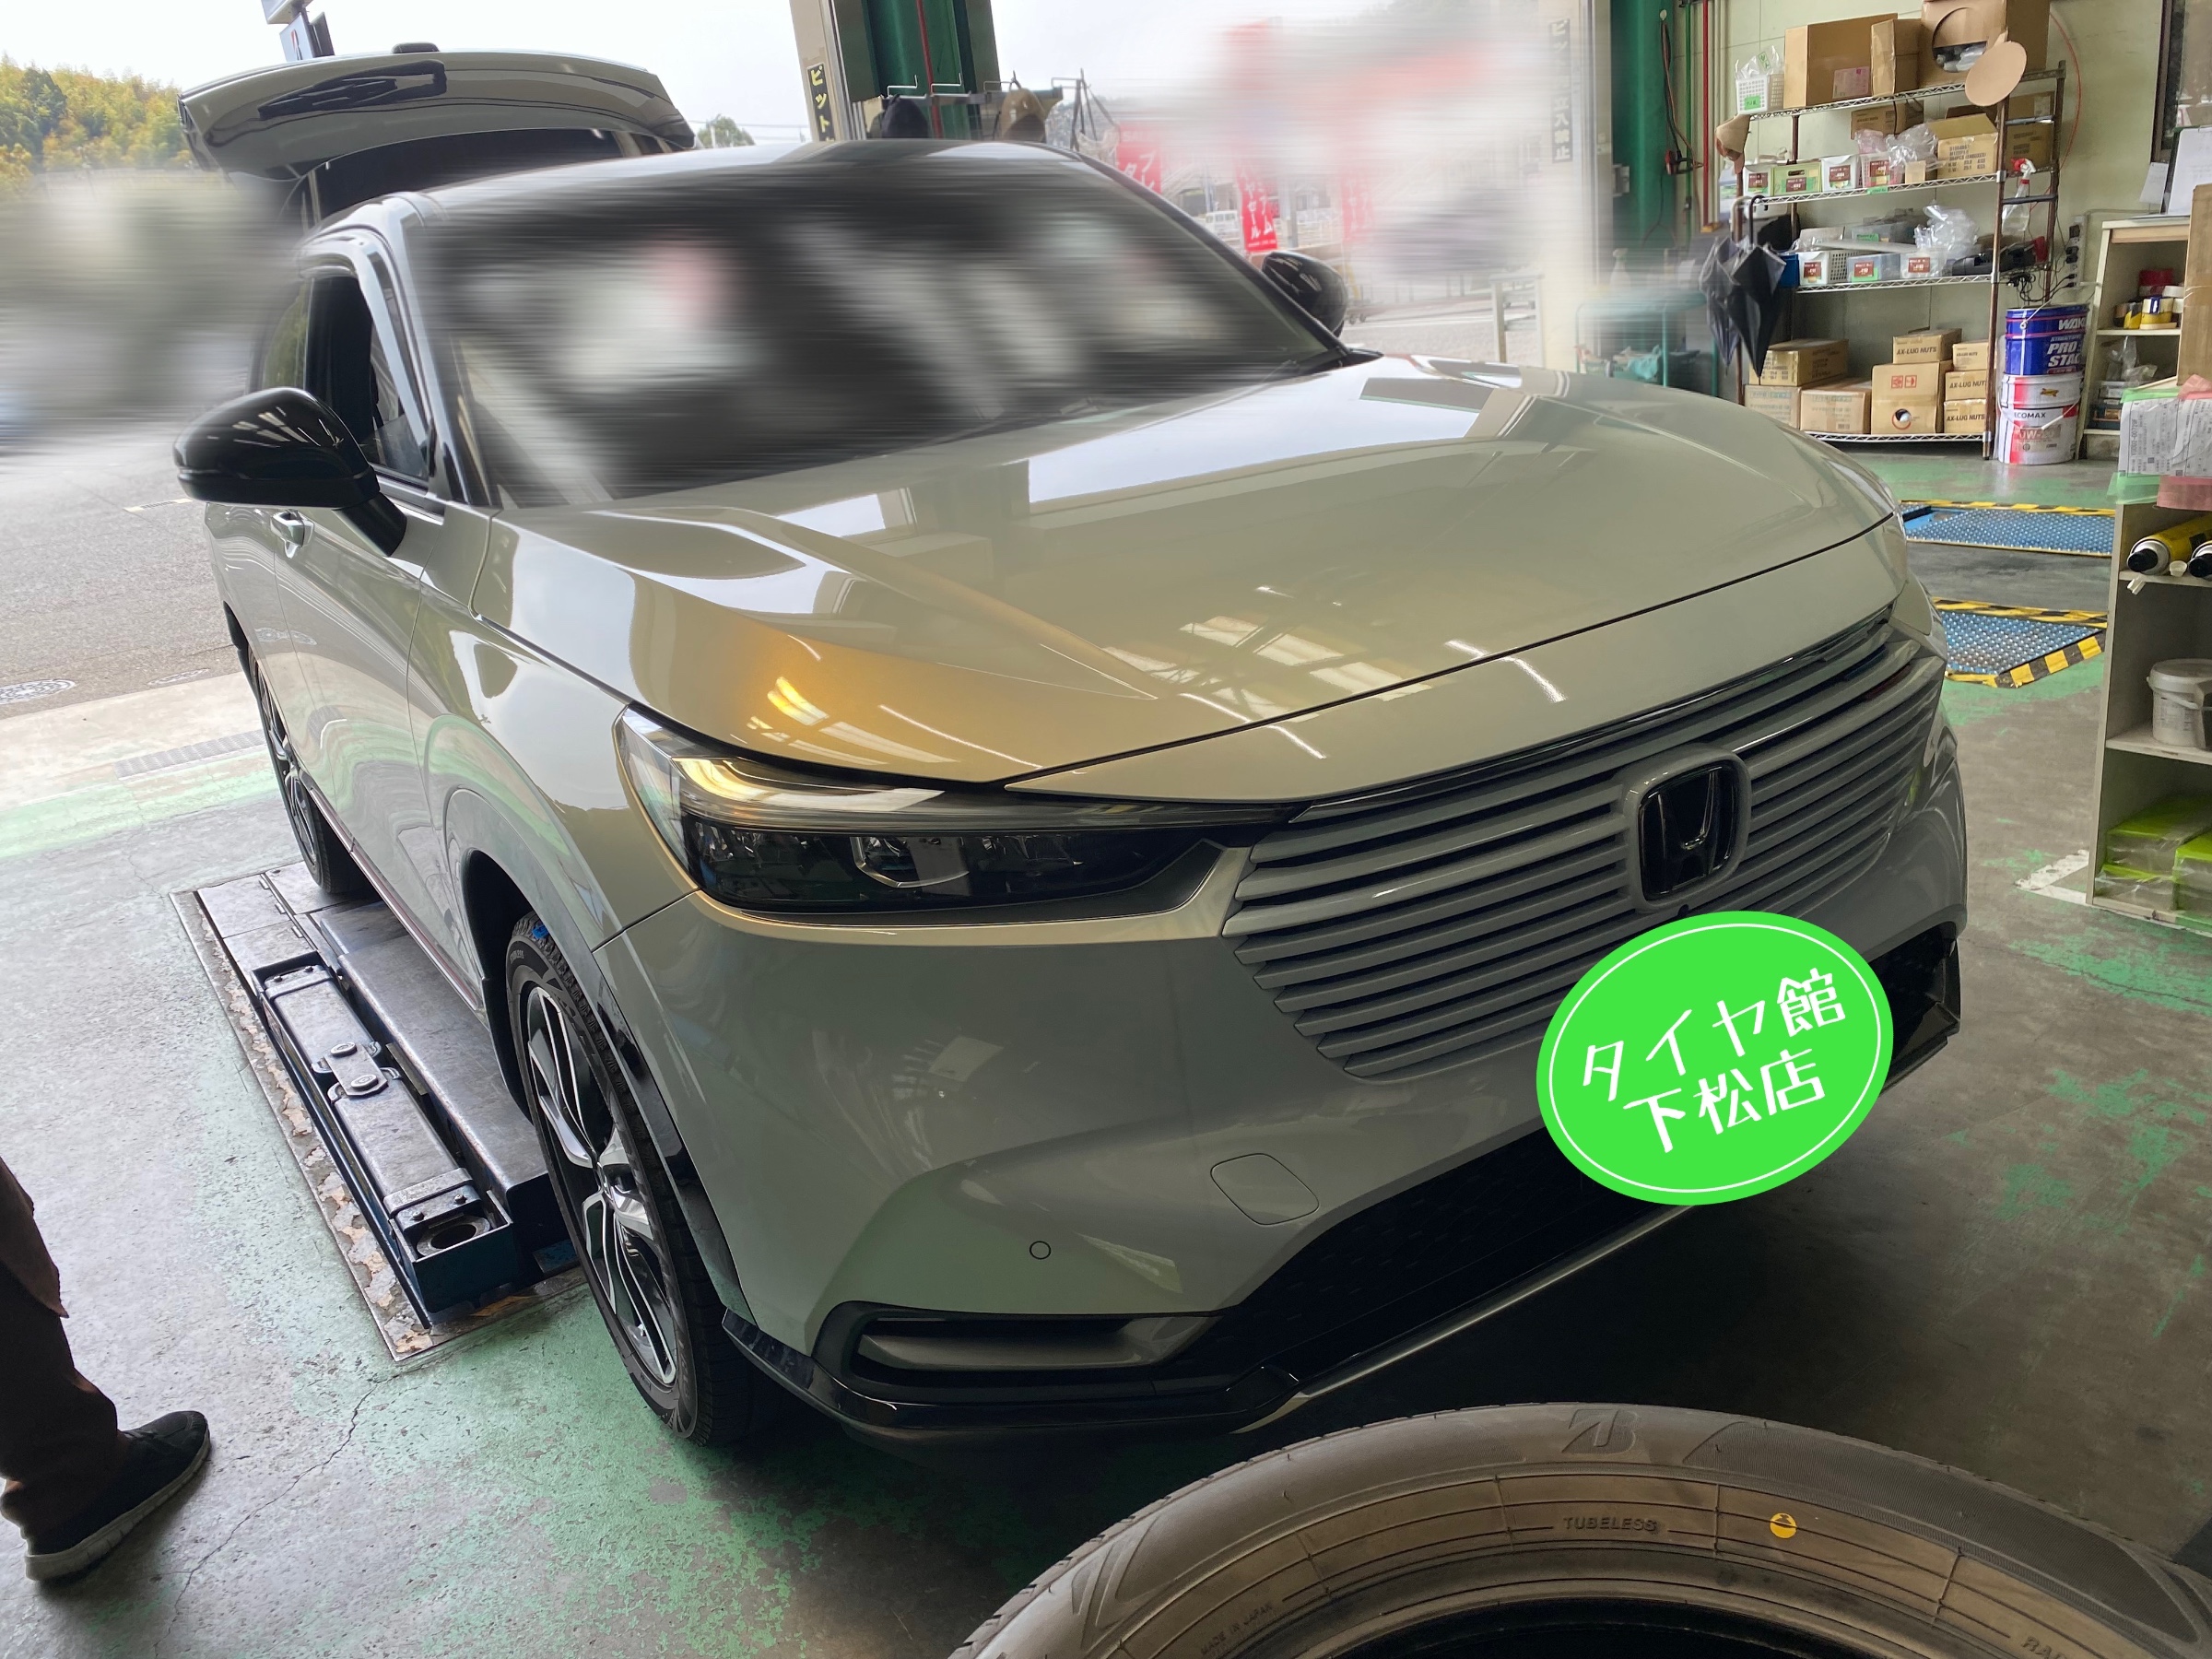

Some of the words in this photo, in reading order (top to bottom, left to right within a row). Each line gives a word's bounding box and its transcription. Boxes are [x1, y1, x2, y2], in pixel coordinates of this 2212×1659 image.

[810, 65, 835, 142] ピット
[2058, 317, 2086, 331] WAK
[1896, 347, 1919, 356] AX-LUG
[1920, 346, 1937, 354] NUTS
[1949, 381, 1971, 389] AX-LUG
[1563, 1516, 1658, 1532] TUBELESS
[1200, 1630, 1227, 1655] MADE
[1243, 1603, 1273, 1626] JAPAN
